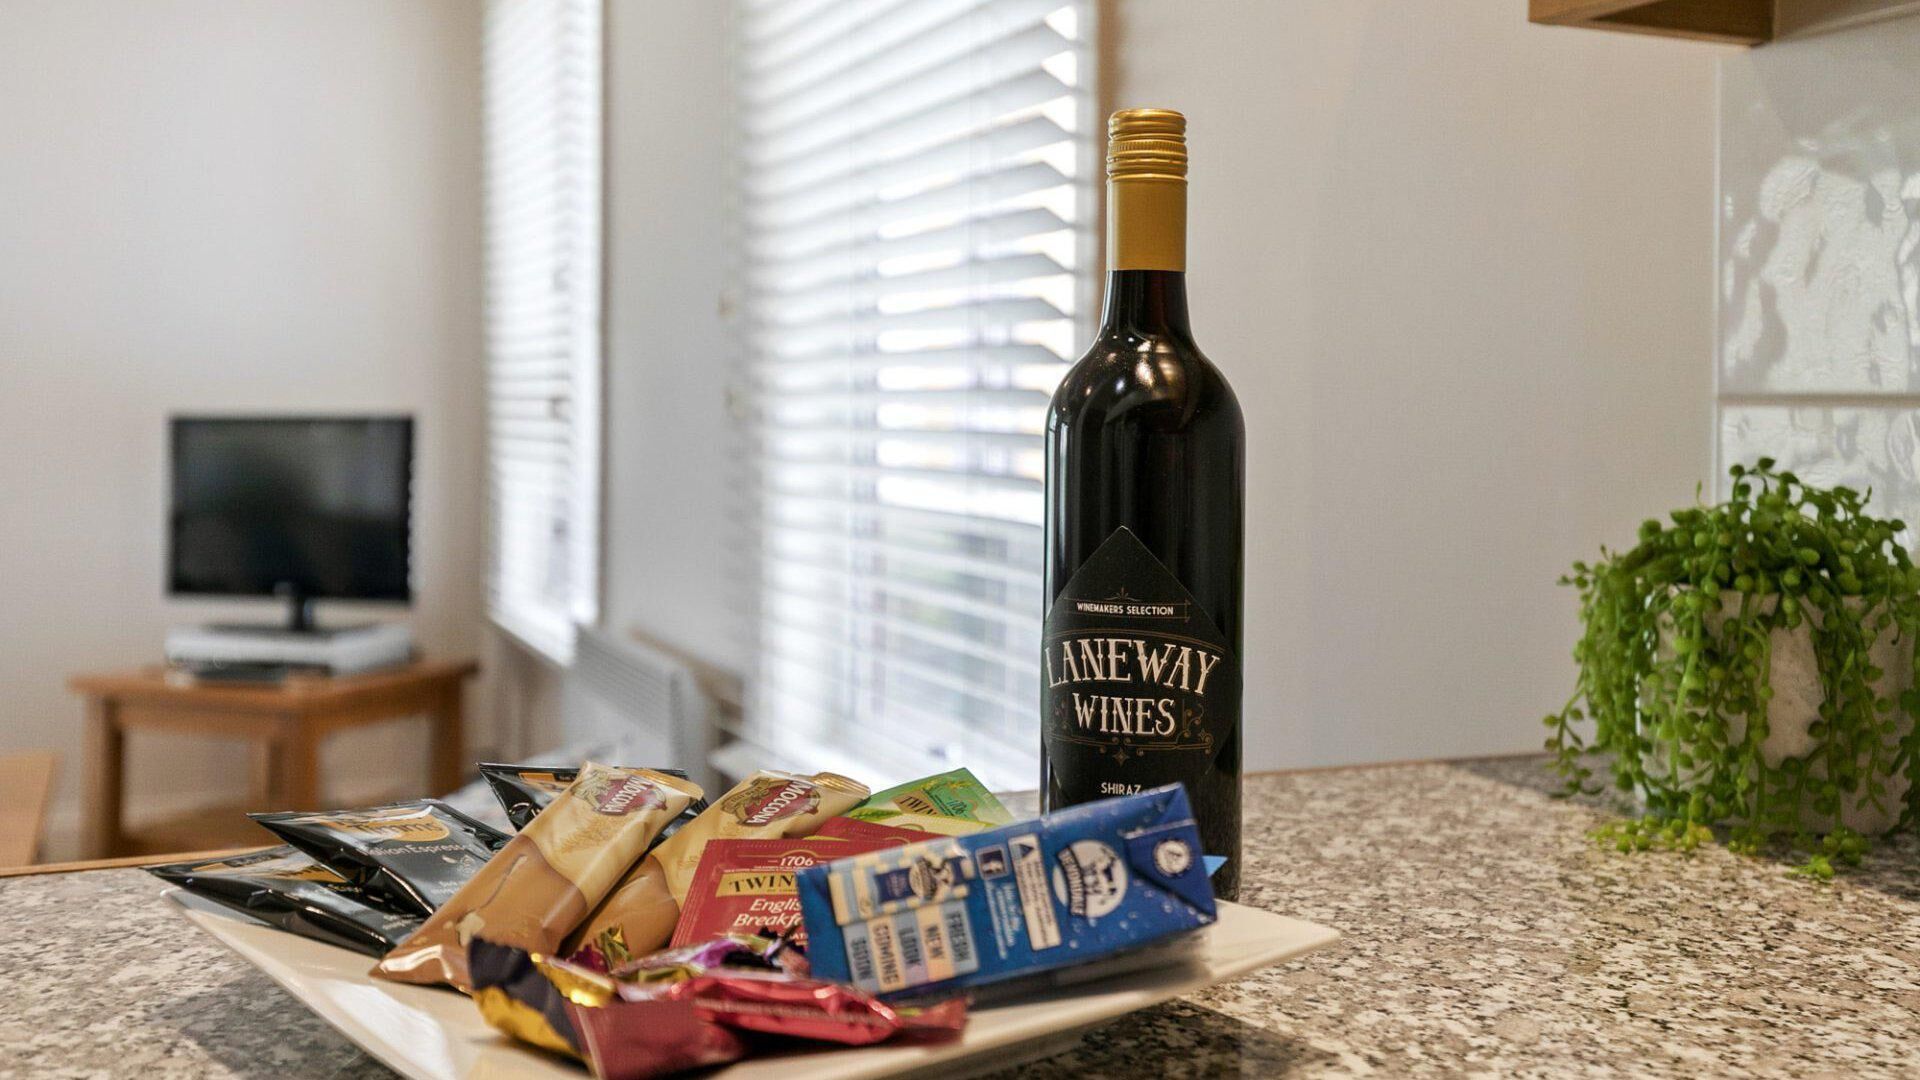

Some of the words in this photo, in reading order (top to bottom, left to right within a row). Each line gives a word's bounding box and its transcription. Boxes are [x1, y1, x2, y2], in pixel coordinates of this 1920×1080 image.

[1076, 602, 1124, 614] WINEMAKERS
[1126, 604, 1174, 616] SELECTION
[1044, 639, 1219, 694] LANEWAY
[1072, 693, 1175, 735] WINES
[745, 780, 812, 824] MOCCONA
[899, 795, 938, 816] TWIN
[1100, 782, 1142, 796] SHIRAZ
[780, 856, 814, 866] 1706
[729, 874, 794, 893] TWIN
[733, 913, 804, 928] Breakf
[749, 898, 802, 914] Englis
[874, 924, 900, 984] COMING
[898, 926, 923, 967] LOOK
[925, 924, 945, 960] NEW
[946, 911, 972, 963] FRESH
[850, 936, 873, 981] SOON
